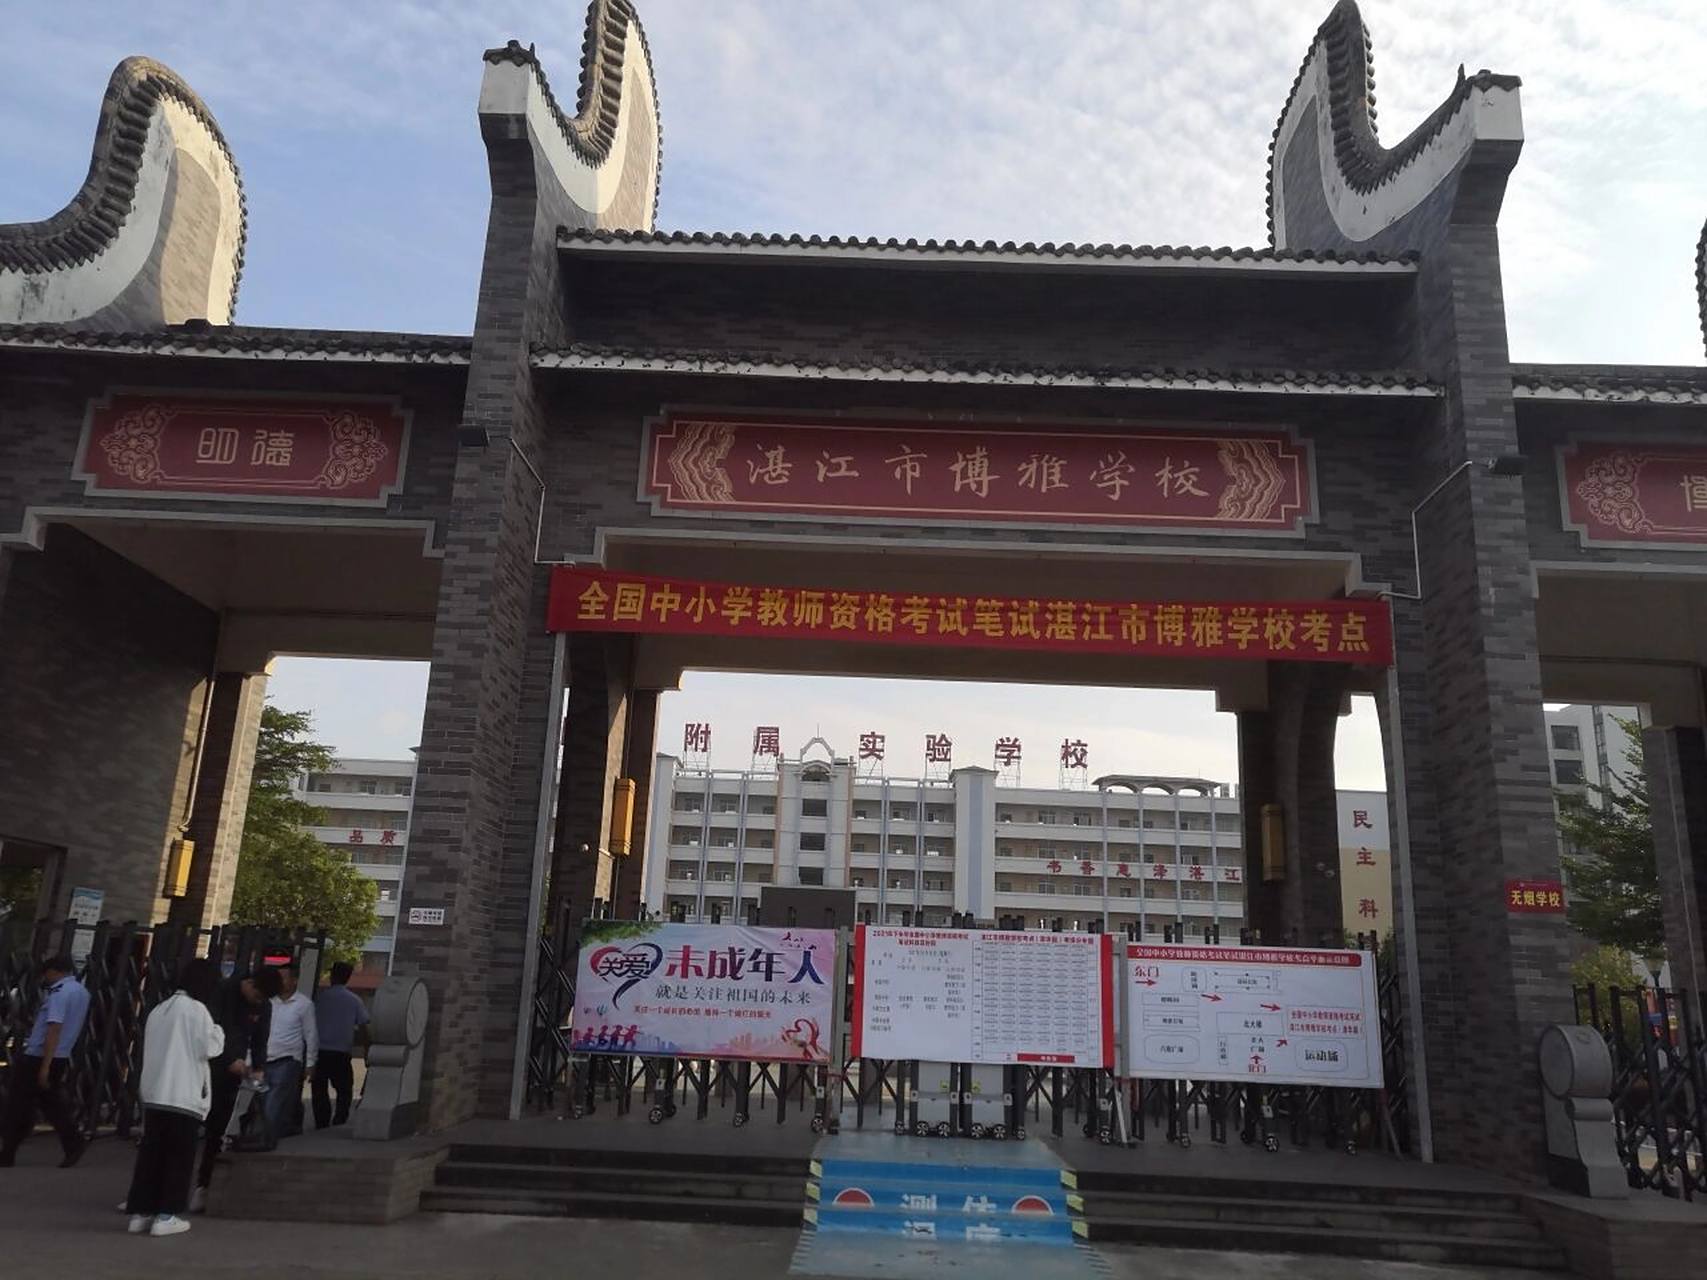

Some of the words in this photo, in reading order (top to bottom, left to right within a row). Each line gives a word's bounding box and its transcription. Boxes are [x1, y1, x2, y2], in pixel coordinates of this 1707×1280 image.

[746, 441, 1212, 501] 湛江市博雅学校
[576, 580, 1370, 653] 全国中小学教师资格考试笔试湛江市博雅学校考点
[683, 722, 1090, 770] 附属实验学校
[1509, 889, 1561, 908] 无烟学校
[599, 952, 651, 979] 关爱
[664, 944, 825, 985] 未成年人
[654, 984, 812, 1005] 就是关注祖国的未来
